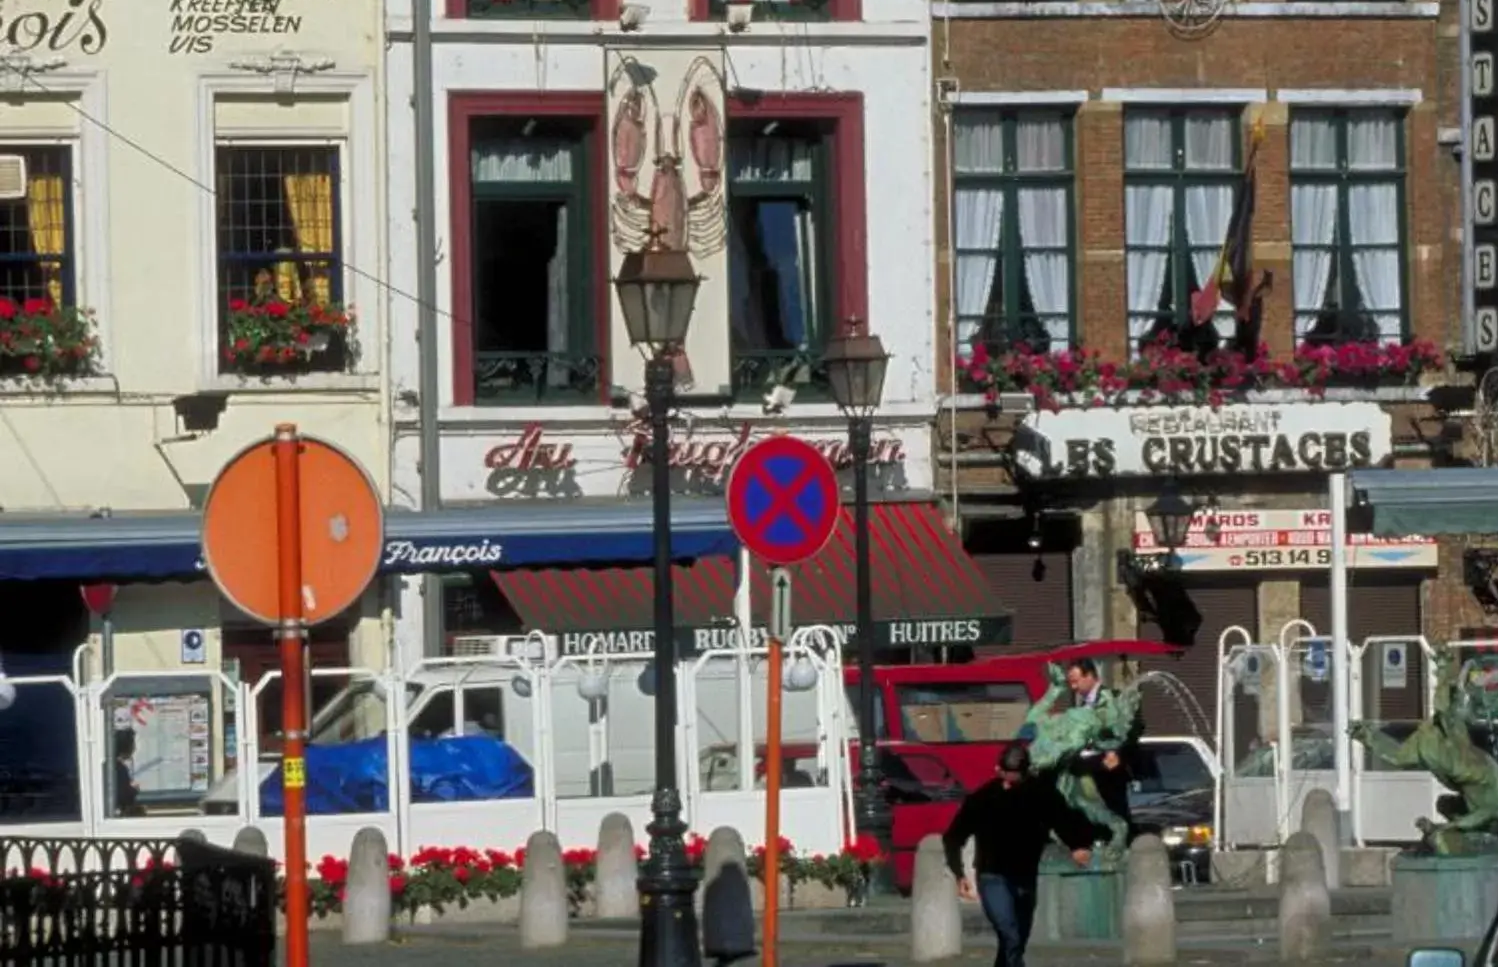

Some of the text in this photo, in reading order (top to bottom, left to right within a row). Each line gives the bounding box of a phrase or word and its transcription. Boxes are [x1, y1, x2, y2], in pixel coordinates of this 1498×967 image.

[171, 16, 302, 33] MOSSELEN
[168, 35, 214, 54] VIS
[1129, 413, 1281, 433] RESTAURANT
[485, 422, 577, 470] Au
[1043, 430, 1372, 475] LES CRUSTACES
[1188, 512, 1260, 529] MARDS
[385, 540, 501, 564] François
[1245, 550, 1332, 566] 513.14.9
[889, 620, 982, 643] HUITRES
